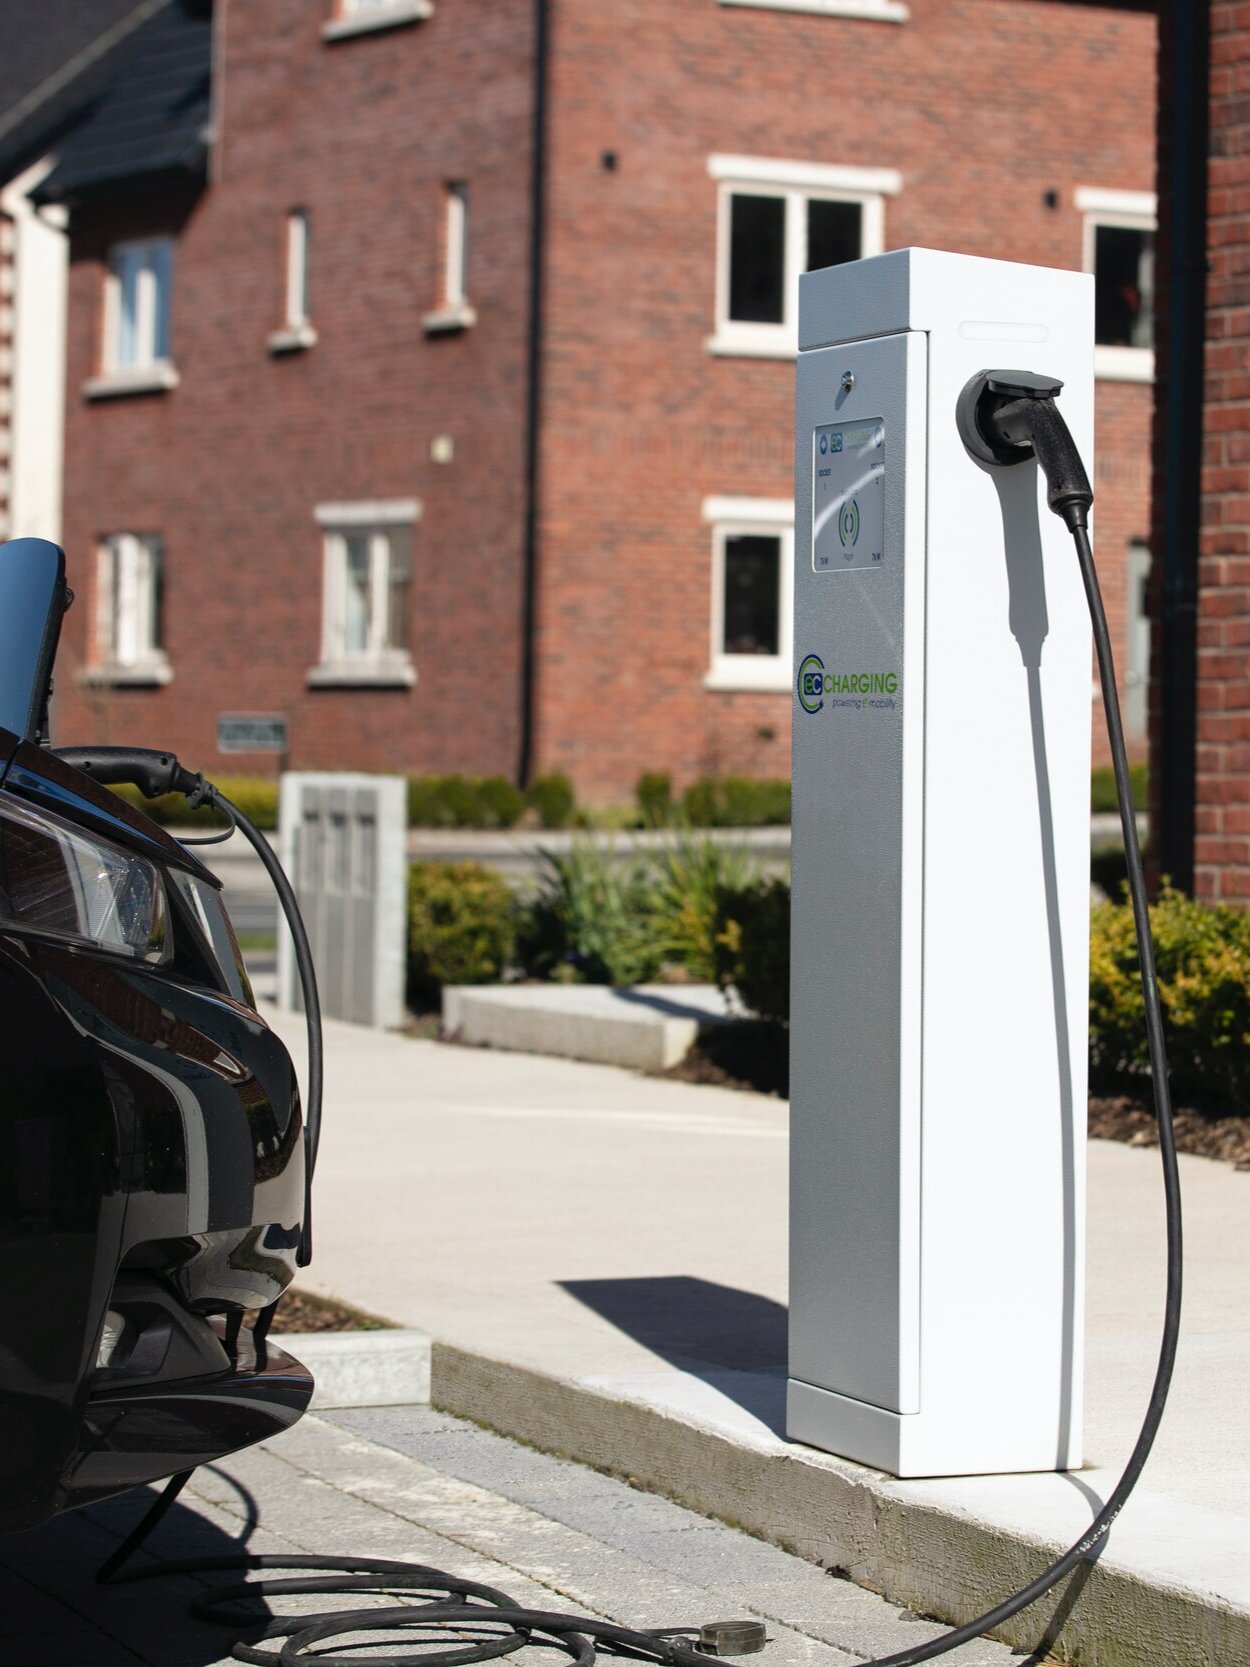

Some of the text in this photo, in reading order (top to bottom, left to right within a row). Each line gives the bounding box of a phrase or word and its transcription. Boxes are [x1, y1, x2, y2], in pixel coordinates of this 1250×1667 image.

[823, 673, 898, 694] CHARGING
[832, 698, 861, 710] powering
[869, 697, 896, 710] mobility
